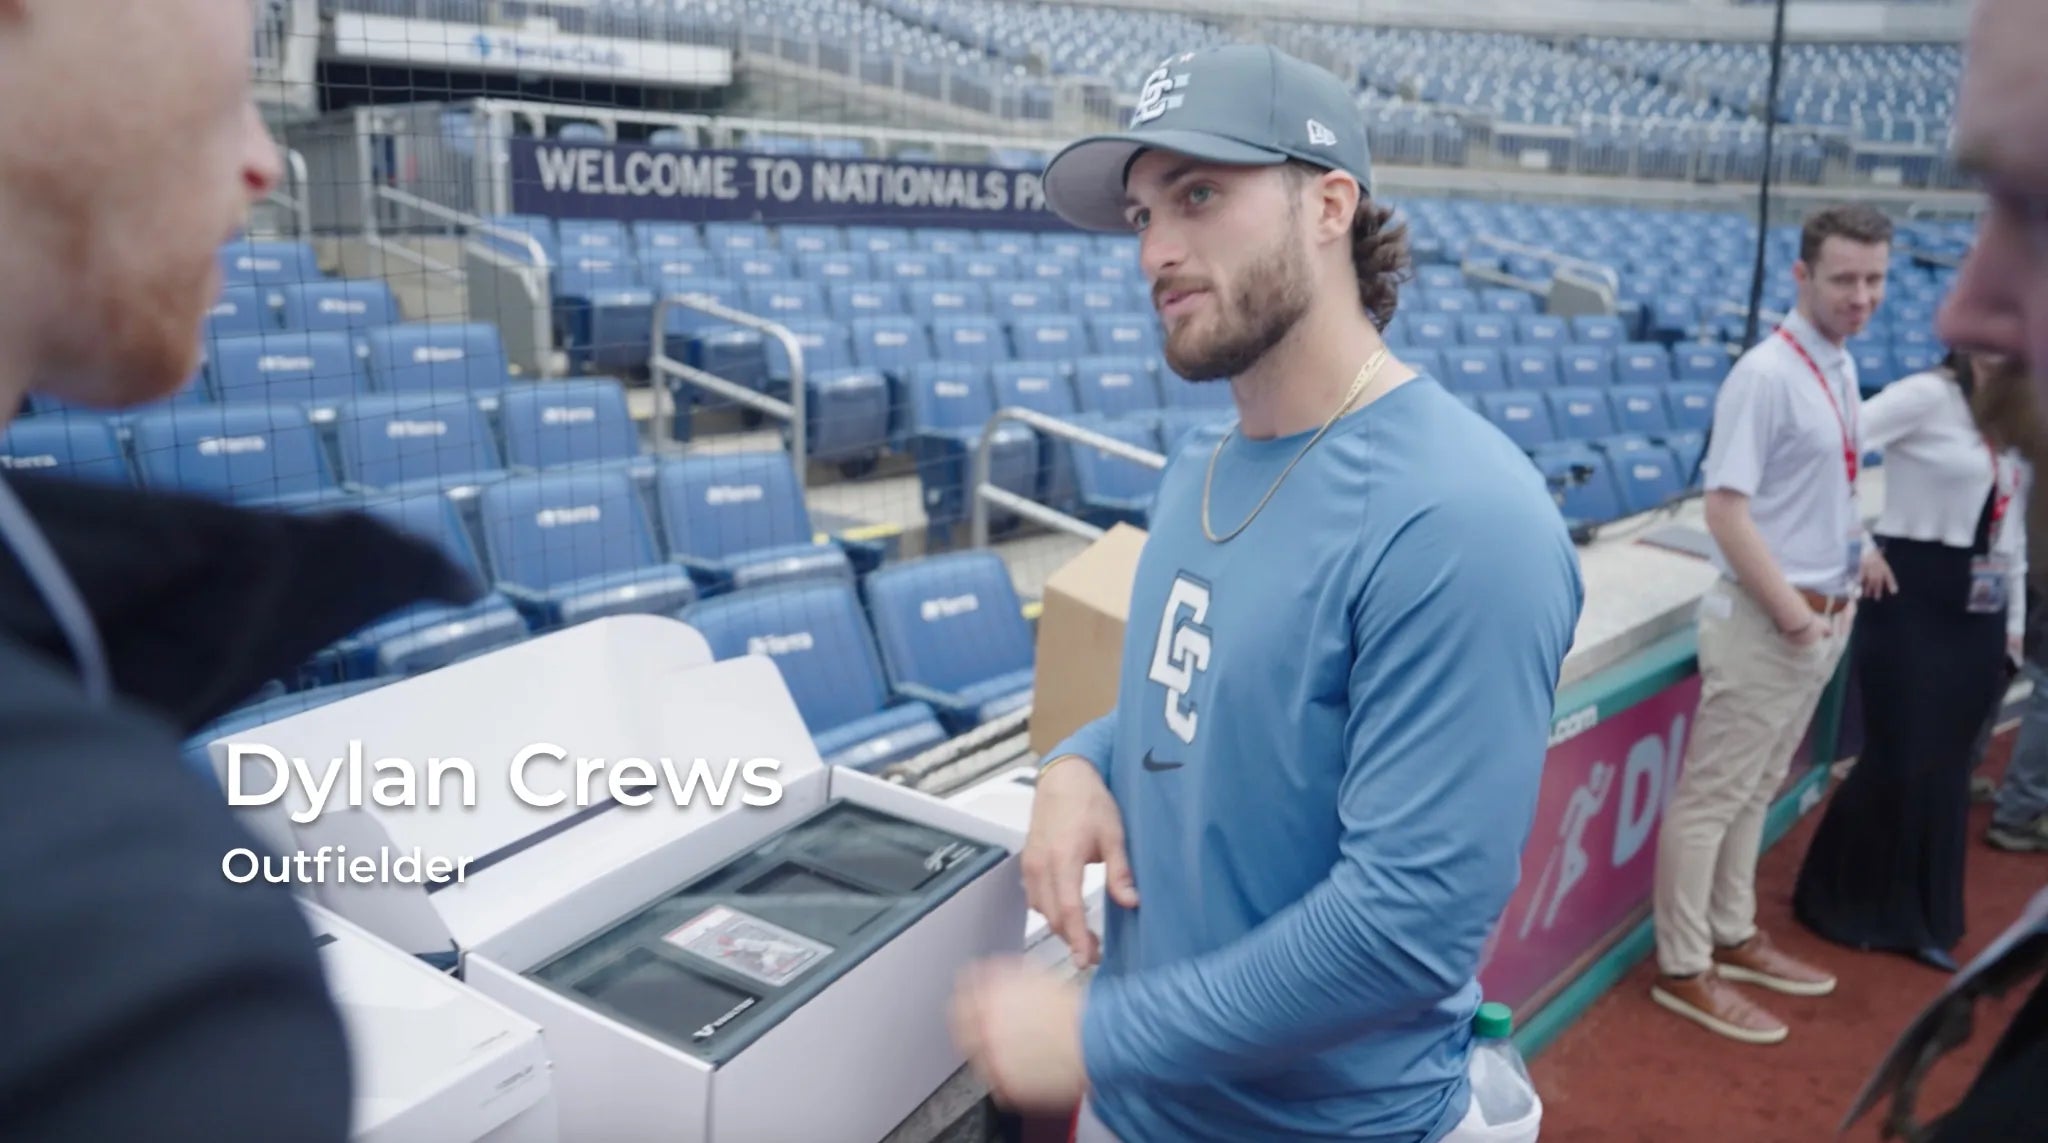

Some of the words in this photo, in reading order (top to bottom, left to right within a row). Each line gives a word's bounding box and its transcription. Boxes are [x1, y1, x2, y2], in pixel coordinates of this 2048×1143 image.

[536, 146, 739, 198] WELCOME
[749, 156, 801, 201] TO
[812, 161, 1007, 210] NATIONALS
